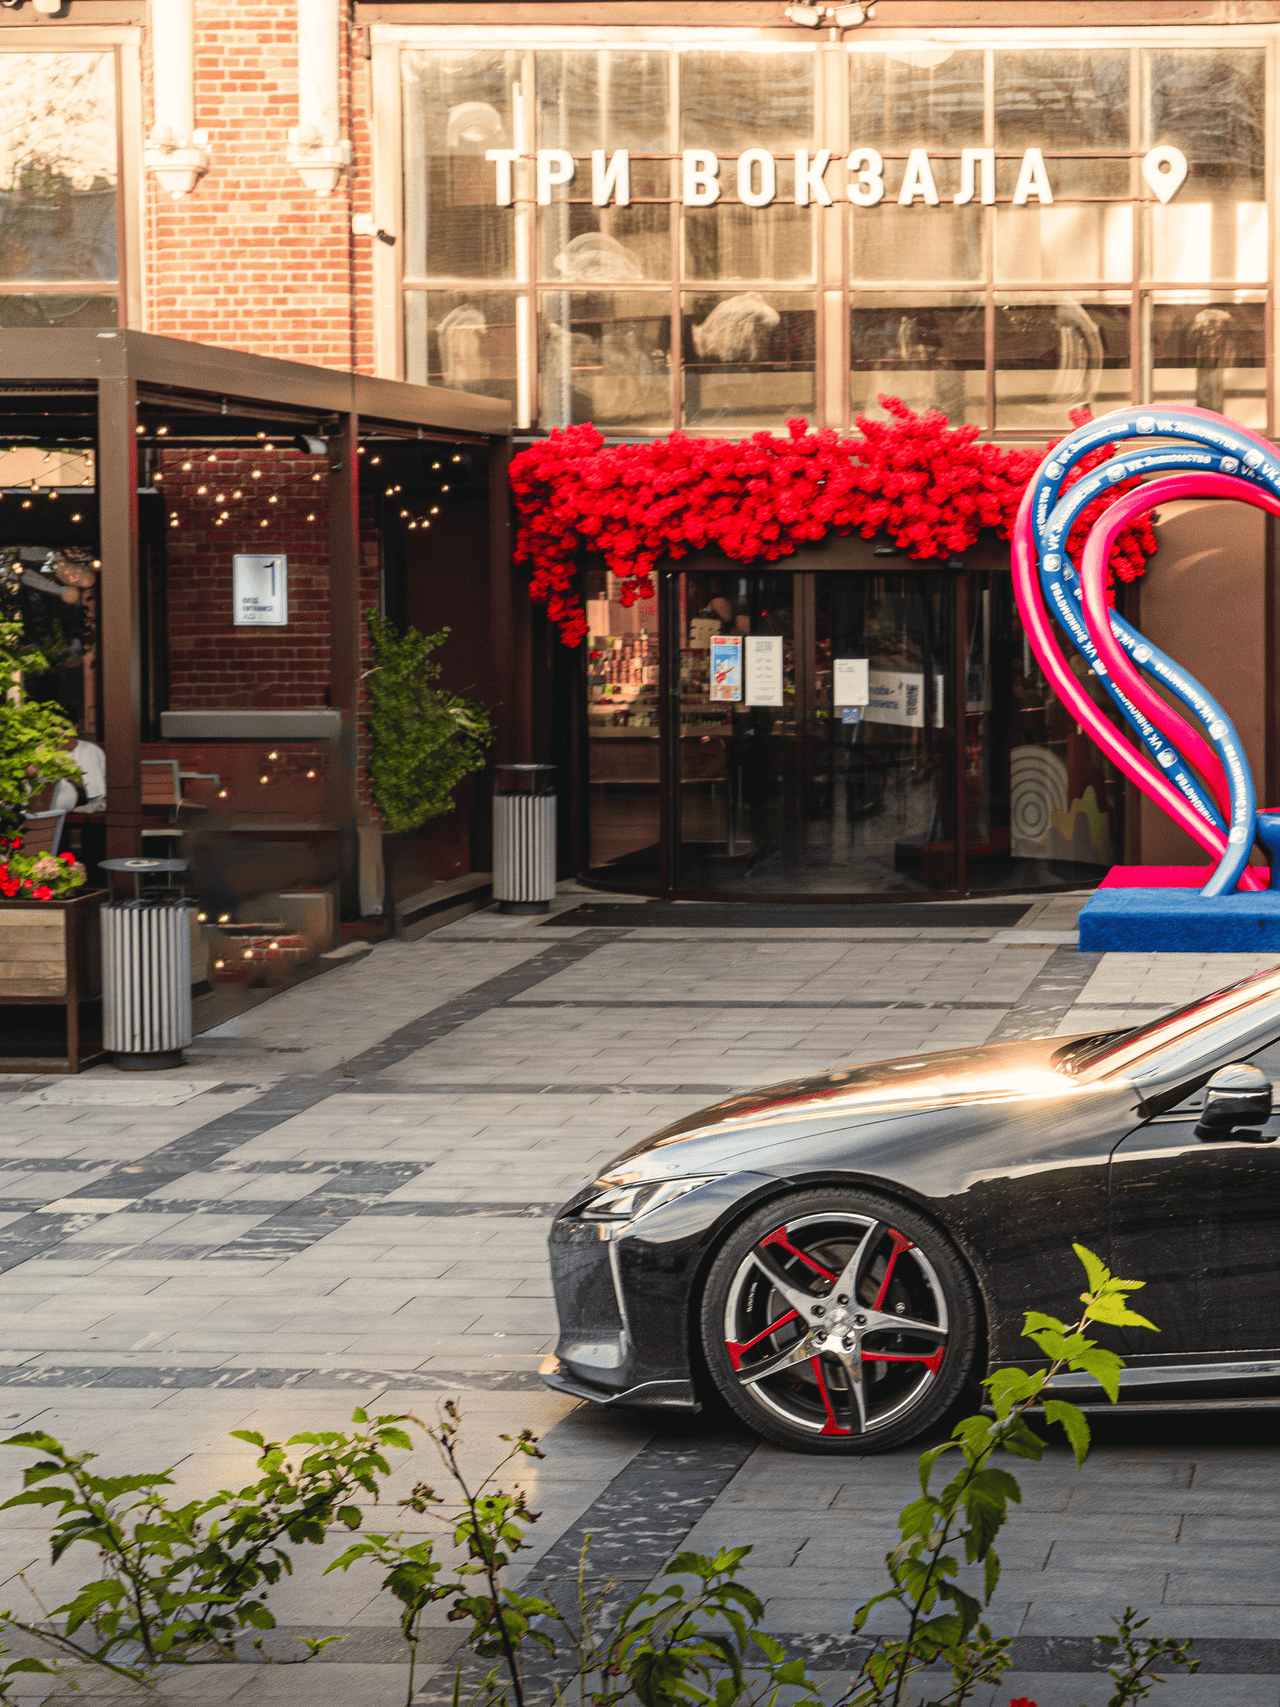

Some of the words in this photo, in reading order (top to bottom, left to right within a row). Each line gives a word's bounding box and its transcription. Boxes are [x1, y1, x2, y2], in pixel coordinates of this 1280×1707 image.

[485, 147, 630, 207] ТРИ
[681, 146, 1054, 208] ВОКЗАЛА
[1262, 463, 1279, 481] VK
[1082, 641, 1098, 658] VK
[1119, 633, 1135, 649] VK
[1200, 705, 1214, 723] VK
[1147, 733, 1163, 750] VK
[1234, 807, 1246, 824] VK
